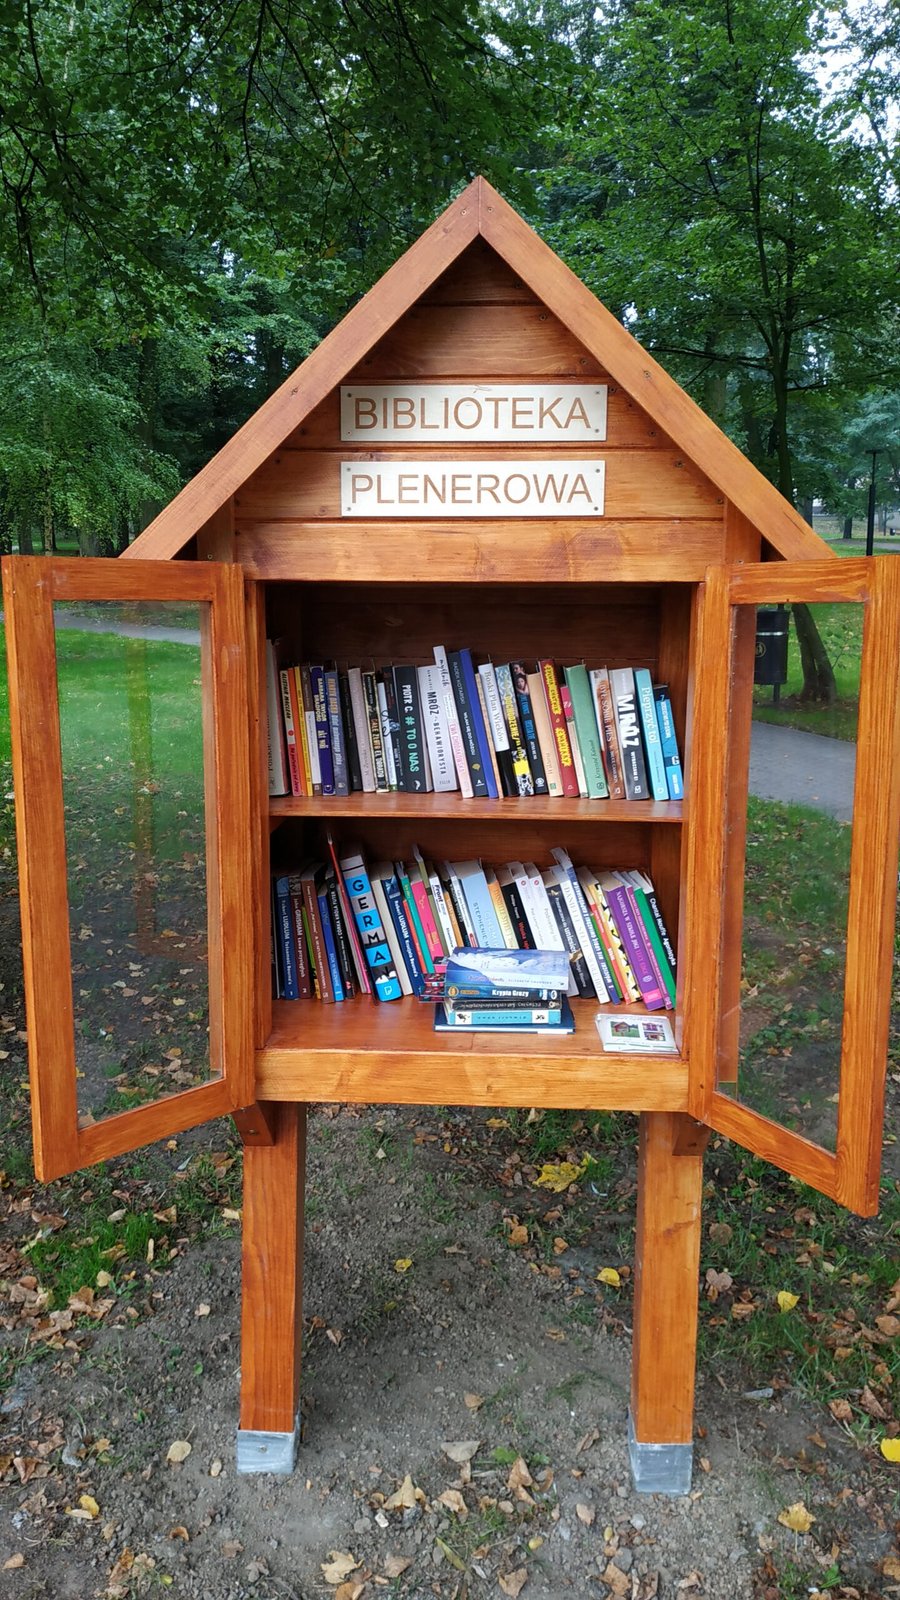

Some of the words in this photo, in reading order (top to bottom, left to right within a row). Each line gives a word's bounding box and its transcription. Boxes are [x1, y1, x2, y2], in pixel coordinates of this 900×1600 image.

[354, 396, 592, 430] BIBLIOTEKA
[351, 473, 593, 504] PLENEROWA
[452, 660, 460, 679] RADEK
[316, 677, 325, 701] BARBARA
[455, 679, 465, 704] KOTARSKI
[483, 670, 495, 693] Boski
[599, 683, 608, 699] BYŁ
[401, 683, 413, 704] PIOTR
[426, 690, 441, 715] MRÓZ
[488, 693, 499, 711] Plan
[283, 695, 292, 719] MACLEAN
[313, 694, 322, 722] BRADFORD
[403, 705, 413, 713] C.
[600, 699, 611, 723] SOBIE
[639, 686, 656, 730] Pieprzyć
[370, 718, 378, 732] CAŁE
[404, 715, 414, 726] #
[449, 722, 457, 735] EWA
[491, 712, 506, 743] Wieków
[616, 694, 640, 749] MRÓZ
[372, 732, 380, 750] ZŁOTO
[405, 727, 416, 740] TO
[466, 731, 472, 739] DO
[604, 724, 613, 742] PIES
[647, 730, 658, 744] to!
[374, 749, 381, 757] EL
[433, 721, 446, 774] BEHAWIORYSTA
[468, 738, 476, 755] MÓZGU
[374, 757, 384, 778] DORADO
[407, 751, 419, 772] NAS
[434, 883, 443, 903] Front
[281, 915, 289, 939] LUDLUM
[294, 909, 302, 935] GRISHAM
[334, 919, 343, 936] CÓRKA
[469, 901, 491, 940] STEPHENIE
[562, 885, 582, 925] DANIELLE
[576, 925, 590, 949] STEEL
[613, 891, 629, 916] NAJGORSZA
[623, 921, 637, 940] SZKOLE
[630, 937, 640, 950] JOGI
[648, 897, 661, 918] Chantal
[655, 917, 666, 936] Mouffe
[393, 900, 401, 915] Robert
[397, 914, 408, 939] LUDLUM
[408, 957, 418, 977] Bourne'a
[661, 936, 676, 967] Agonistyka
[572, 960, 582, 973] ndigo
[512, 989, 530, 998] Grozy
